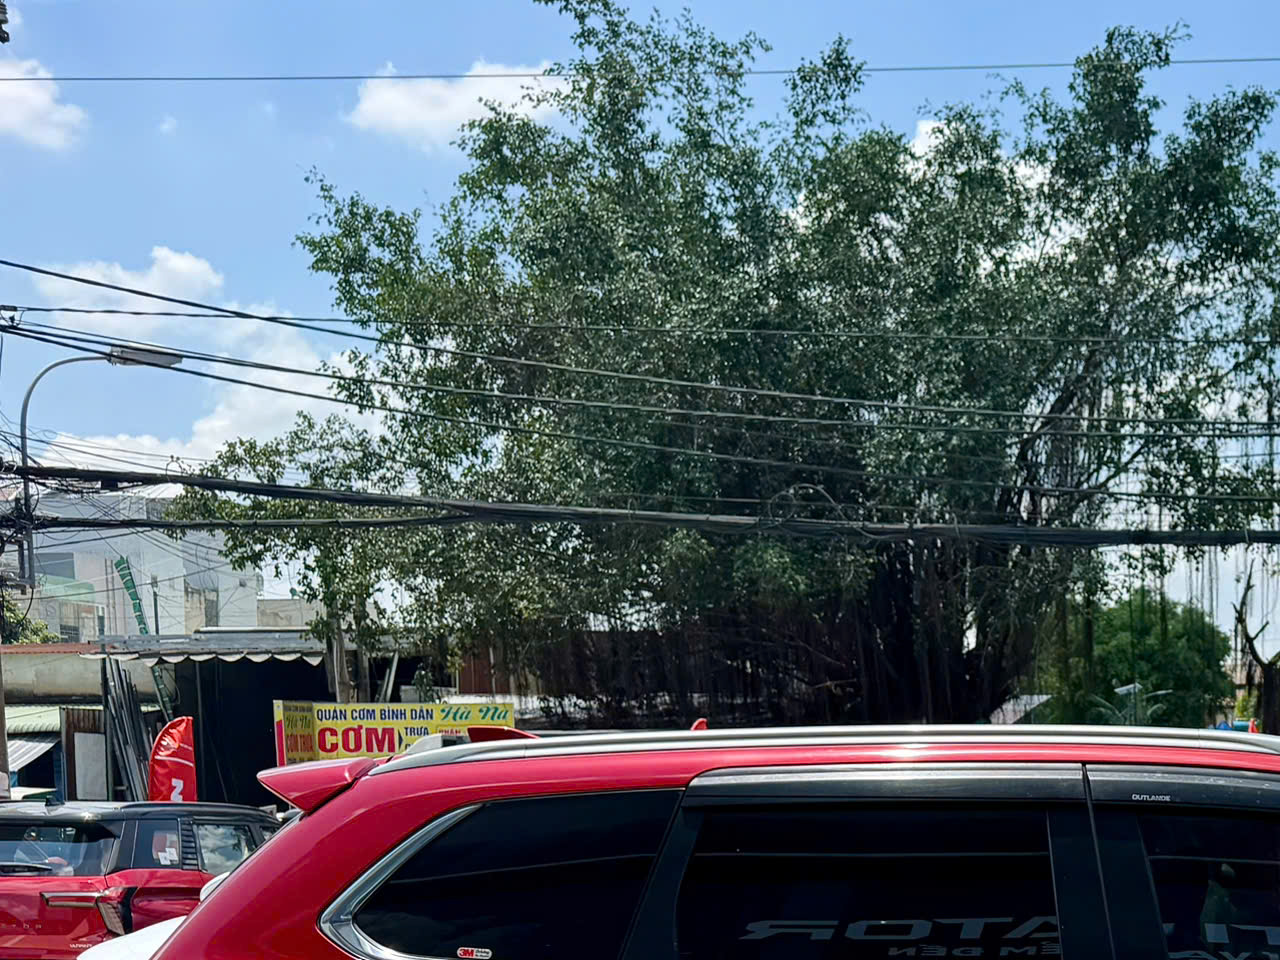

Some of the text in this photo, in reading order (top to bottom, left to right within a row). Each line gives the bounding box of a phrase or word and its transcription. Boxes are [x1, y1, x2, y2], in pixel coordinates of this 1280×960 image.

[316, 707, 347, 722] QUÁN
[350, 707, 376, 721] CƠM
[380, 706, 407, 721] BÌNH
[410, 706, 434, 721] DÂN
[317, 724, 396, 753] CƠM
[460, 947, 475, 959] 3M
